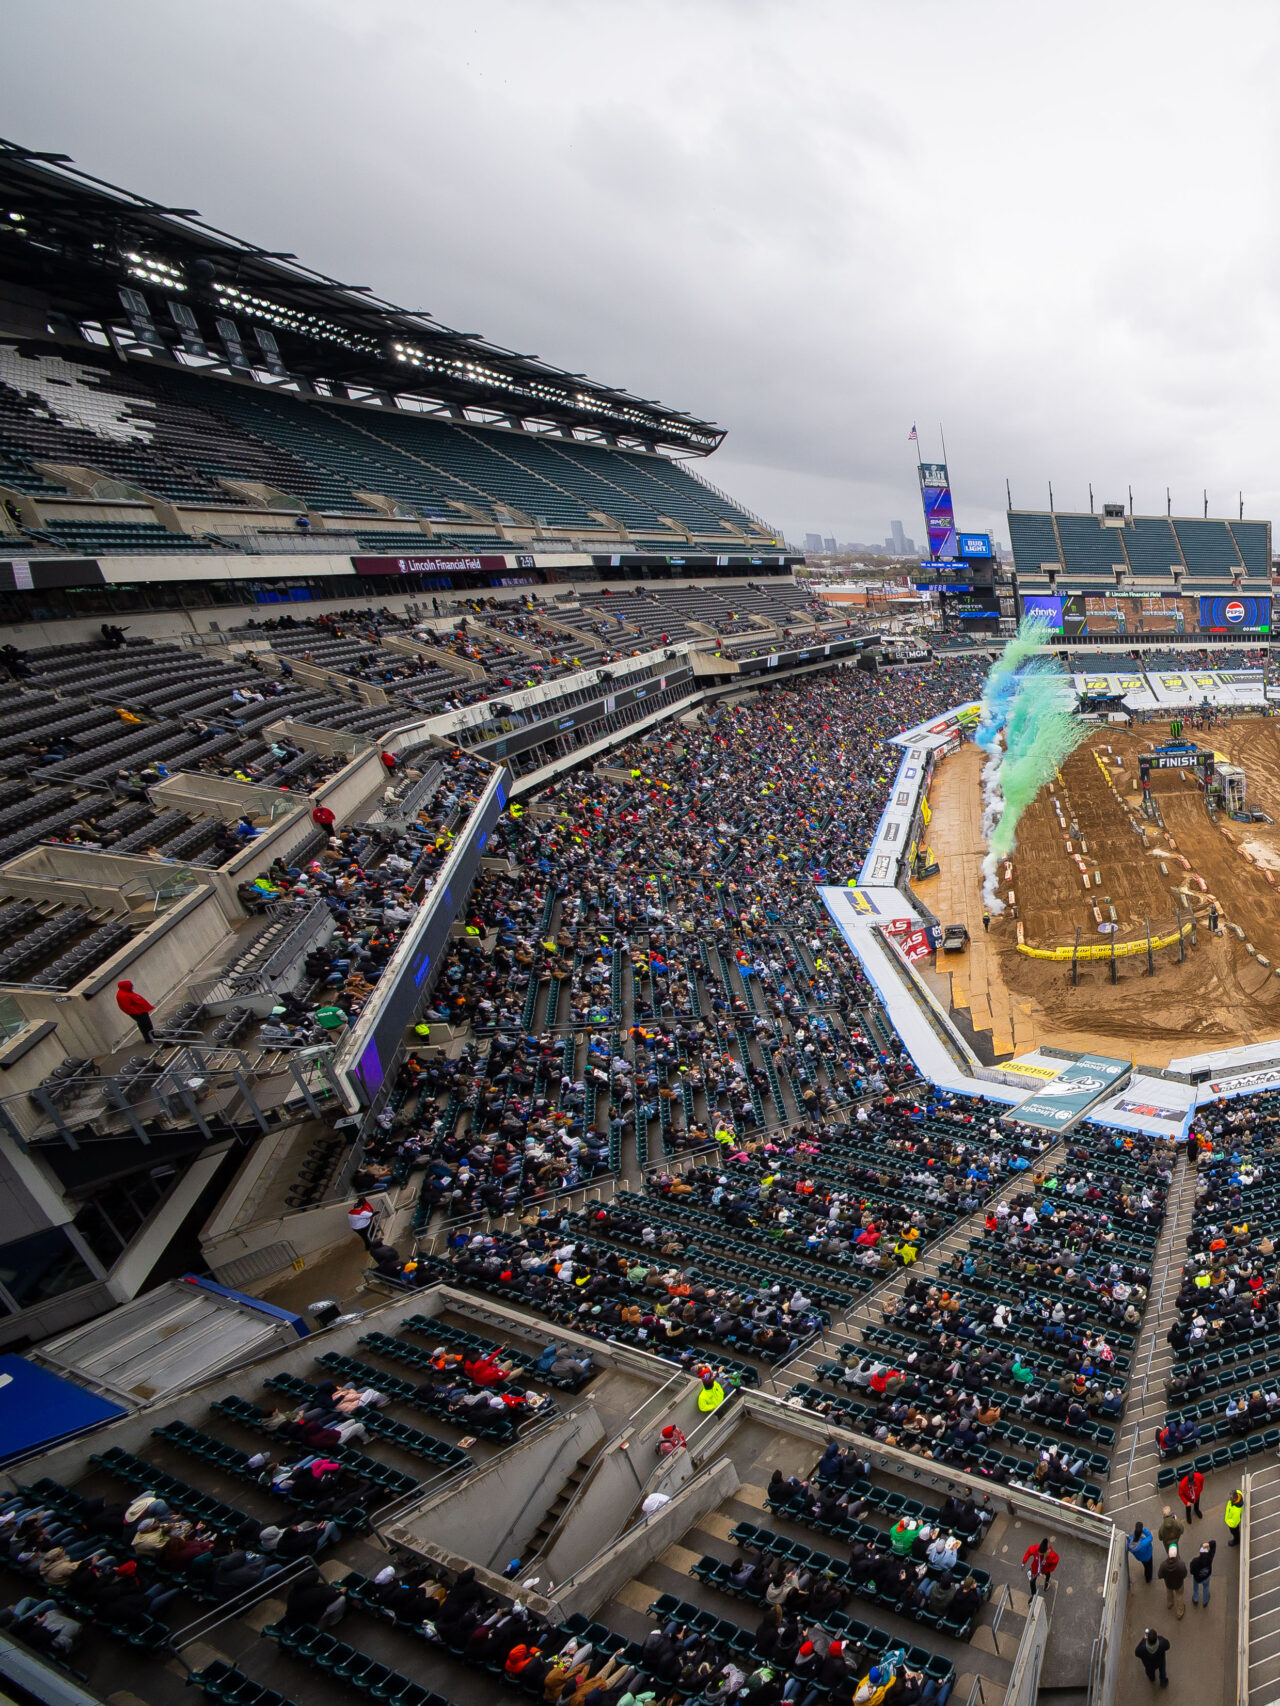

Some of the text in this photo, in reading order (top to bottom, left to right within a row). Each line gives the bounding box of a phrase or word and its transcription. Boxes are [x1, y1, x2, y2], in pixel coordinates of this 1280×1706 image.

[408, 559, 481, 571] Lincoln Financial Field
[521, 556, 533, 567] 2:59
[1030, 607, 1058, 617] xfinity
[895, 650, 928, 659] BETMGM
[1159, 756, 1198, 768] FINISH
[1003, 1063, 1055, 1078] Insta360
[1076, 1062, 1106, 1072] Lincoln
[1221, 1078, 1267, 1091] MOUNTAIN
[1021, 1105, 1056, 1117] Lincoln
